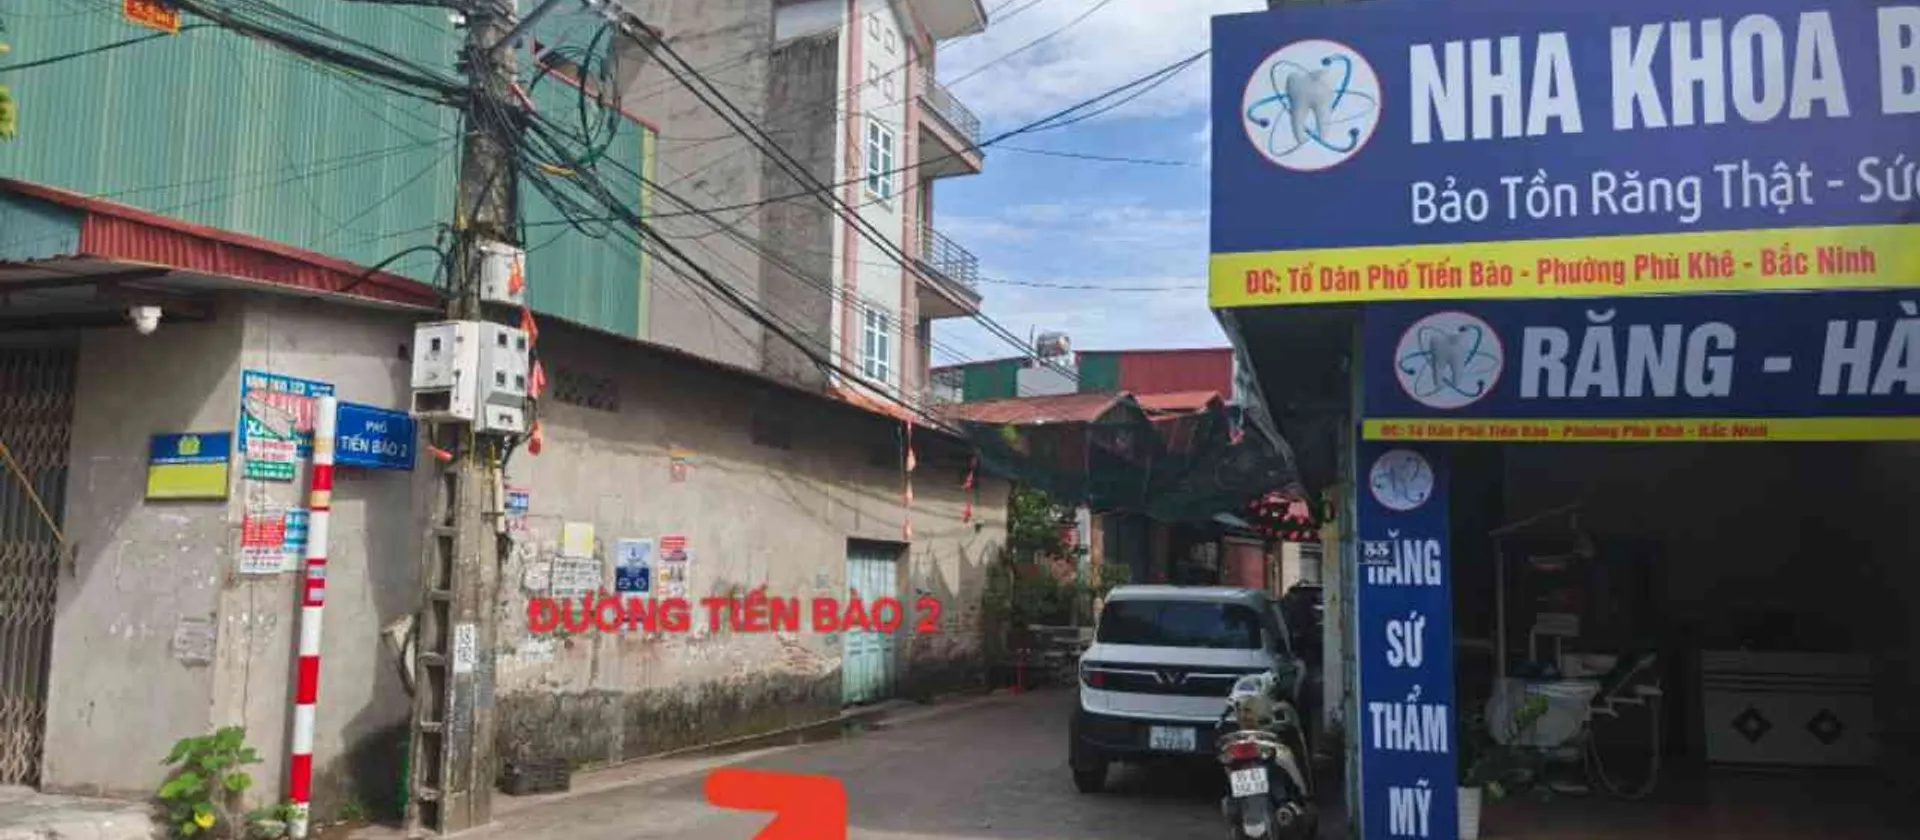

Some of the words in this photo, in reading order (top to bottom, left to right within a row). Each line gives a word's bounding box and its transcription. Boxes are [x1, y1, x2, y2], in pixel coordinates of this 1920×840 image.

[1410, 32, 1583, 144] NHA
[1610, 11, 1850, 130] KHOA
[1412, 178, 1488, 225] Bảo
[1501, 169, 1577, 219] Tồn
[1592, 170, 1702, 223] Răng
[1713, 158, 1814, 215] Thật
[1858, 153, 1920, 203] Sứ
[1368, 257, 1412, 290] Phố
[1416, 256, 1463, 289] Tiến
[1537, 256, 1626, 287] Phường
[1688, 250, 1735, 279] Khê
[1760, 242, 1808, 276] Bắc
[1816, 246, 1876, 275] Ninh
[1520, 308, 1737, 398] RĂNG
[1386, 611, 1426, 668] SỨ
[1369, 684, 1449, 753] THẨM
[1389, 780, 1433, 838] MỸ
